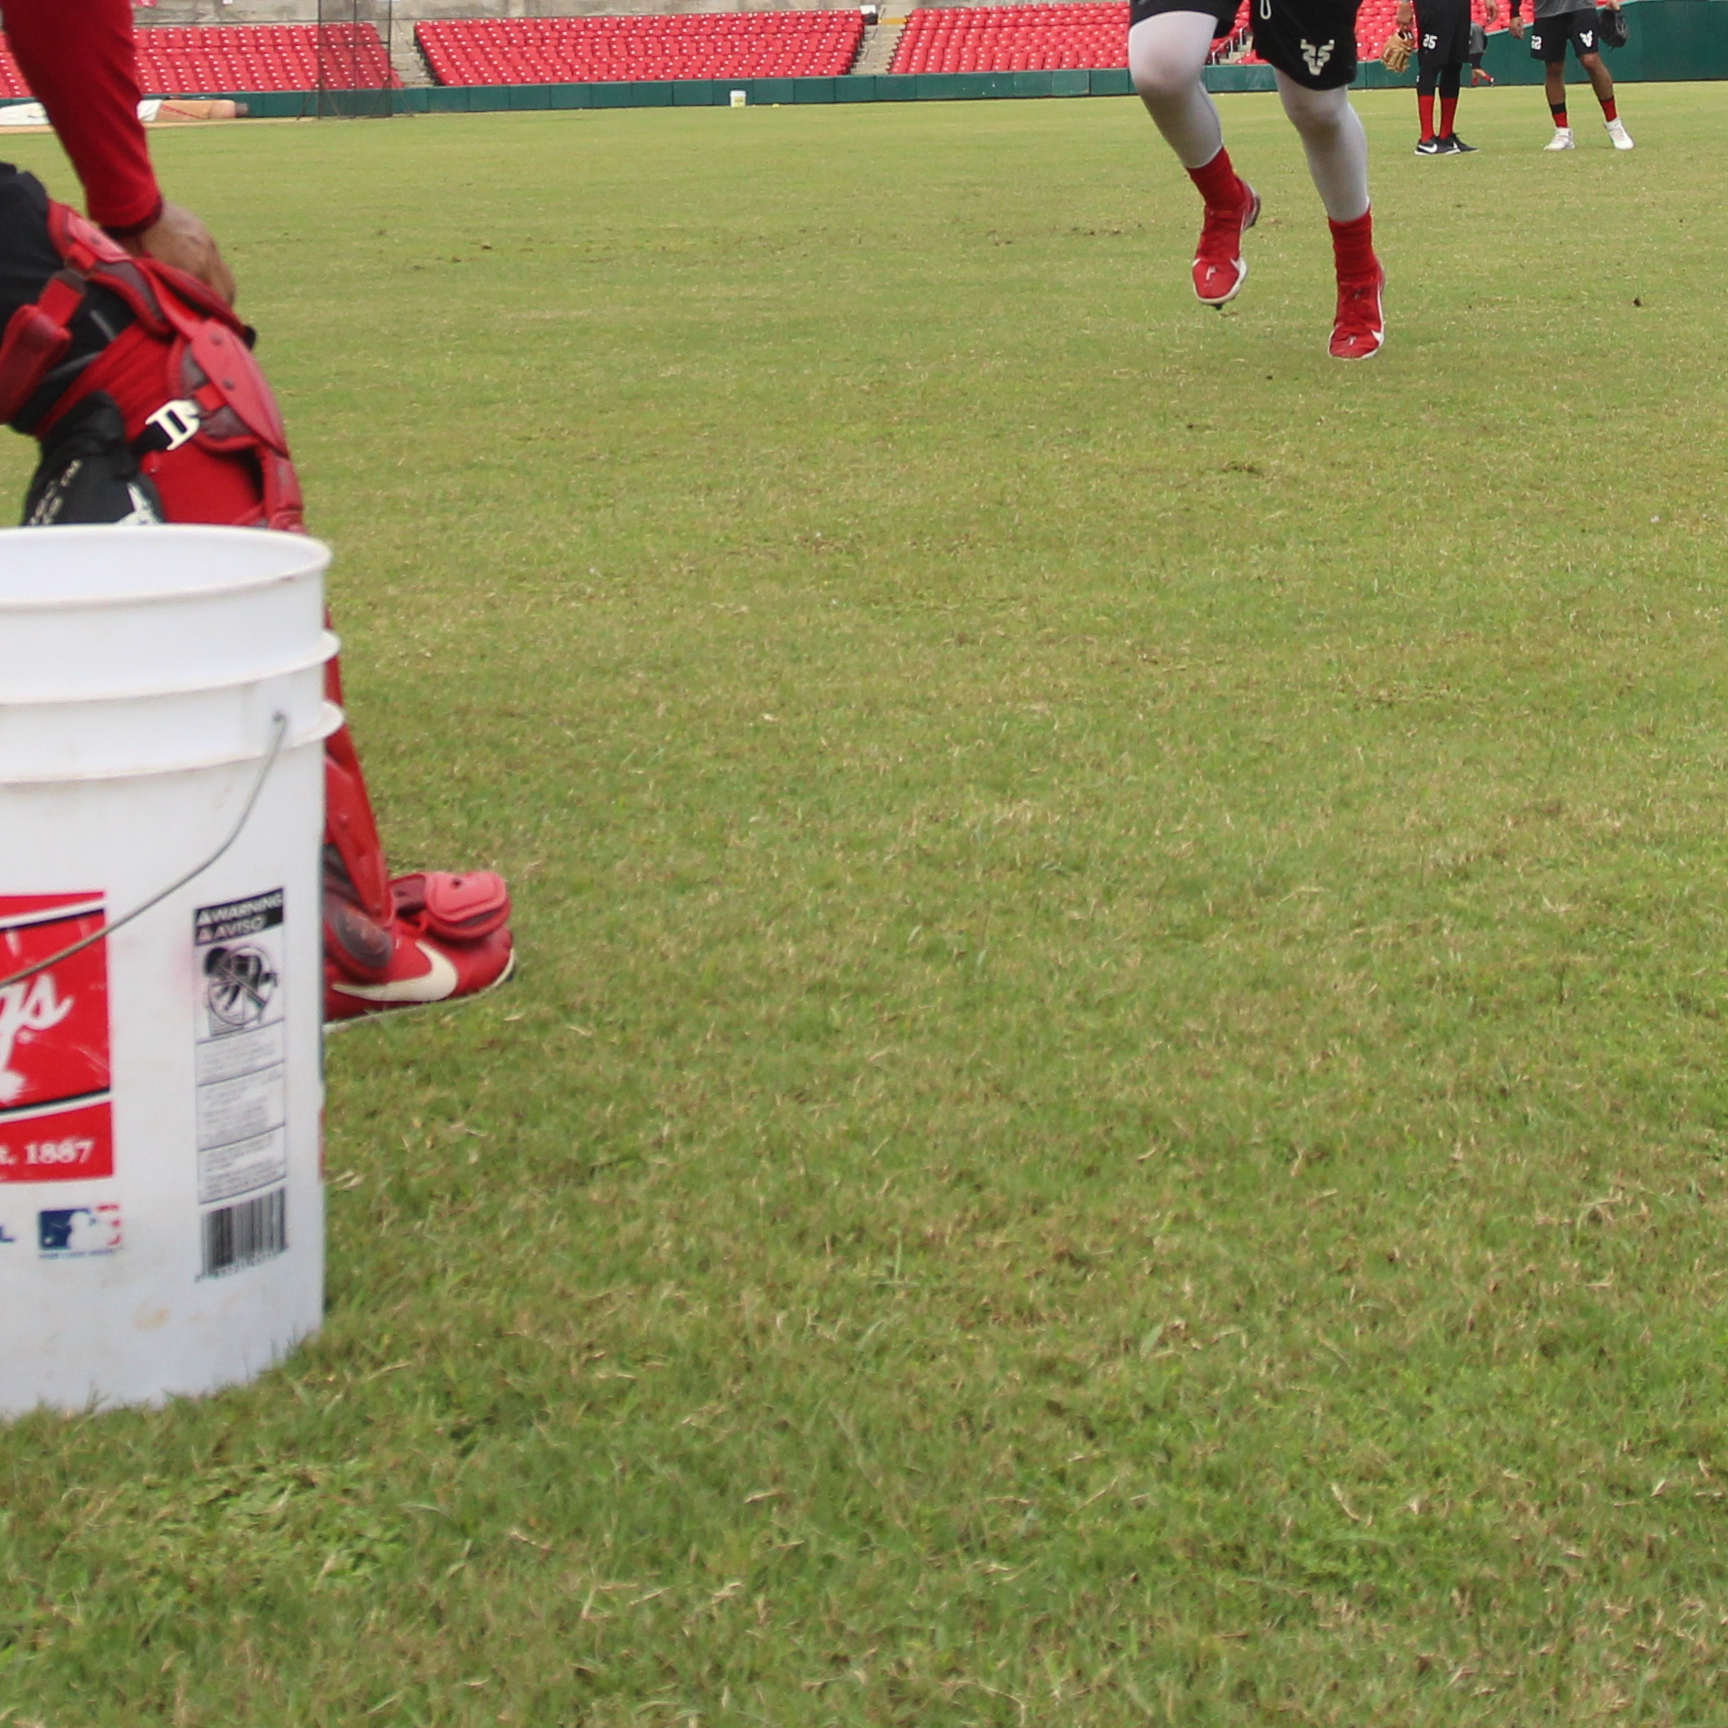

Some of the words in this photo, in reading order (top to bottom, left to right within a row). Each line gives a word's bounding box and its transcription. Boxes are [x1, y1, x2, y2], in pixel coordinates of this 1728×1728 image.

[214, 892, 283, 920] WARNING
[213, 917, 264, 939] AVISO
[24, 1138, 95, 1165] 1887
